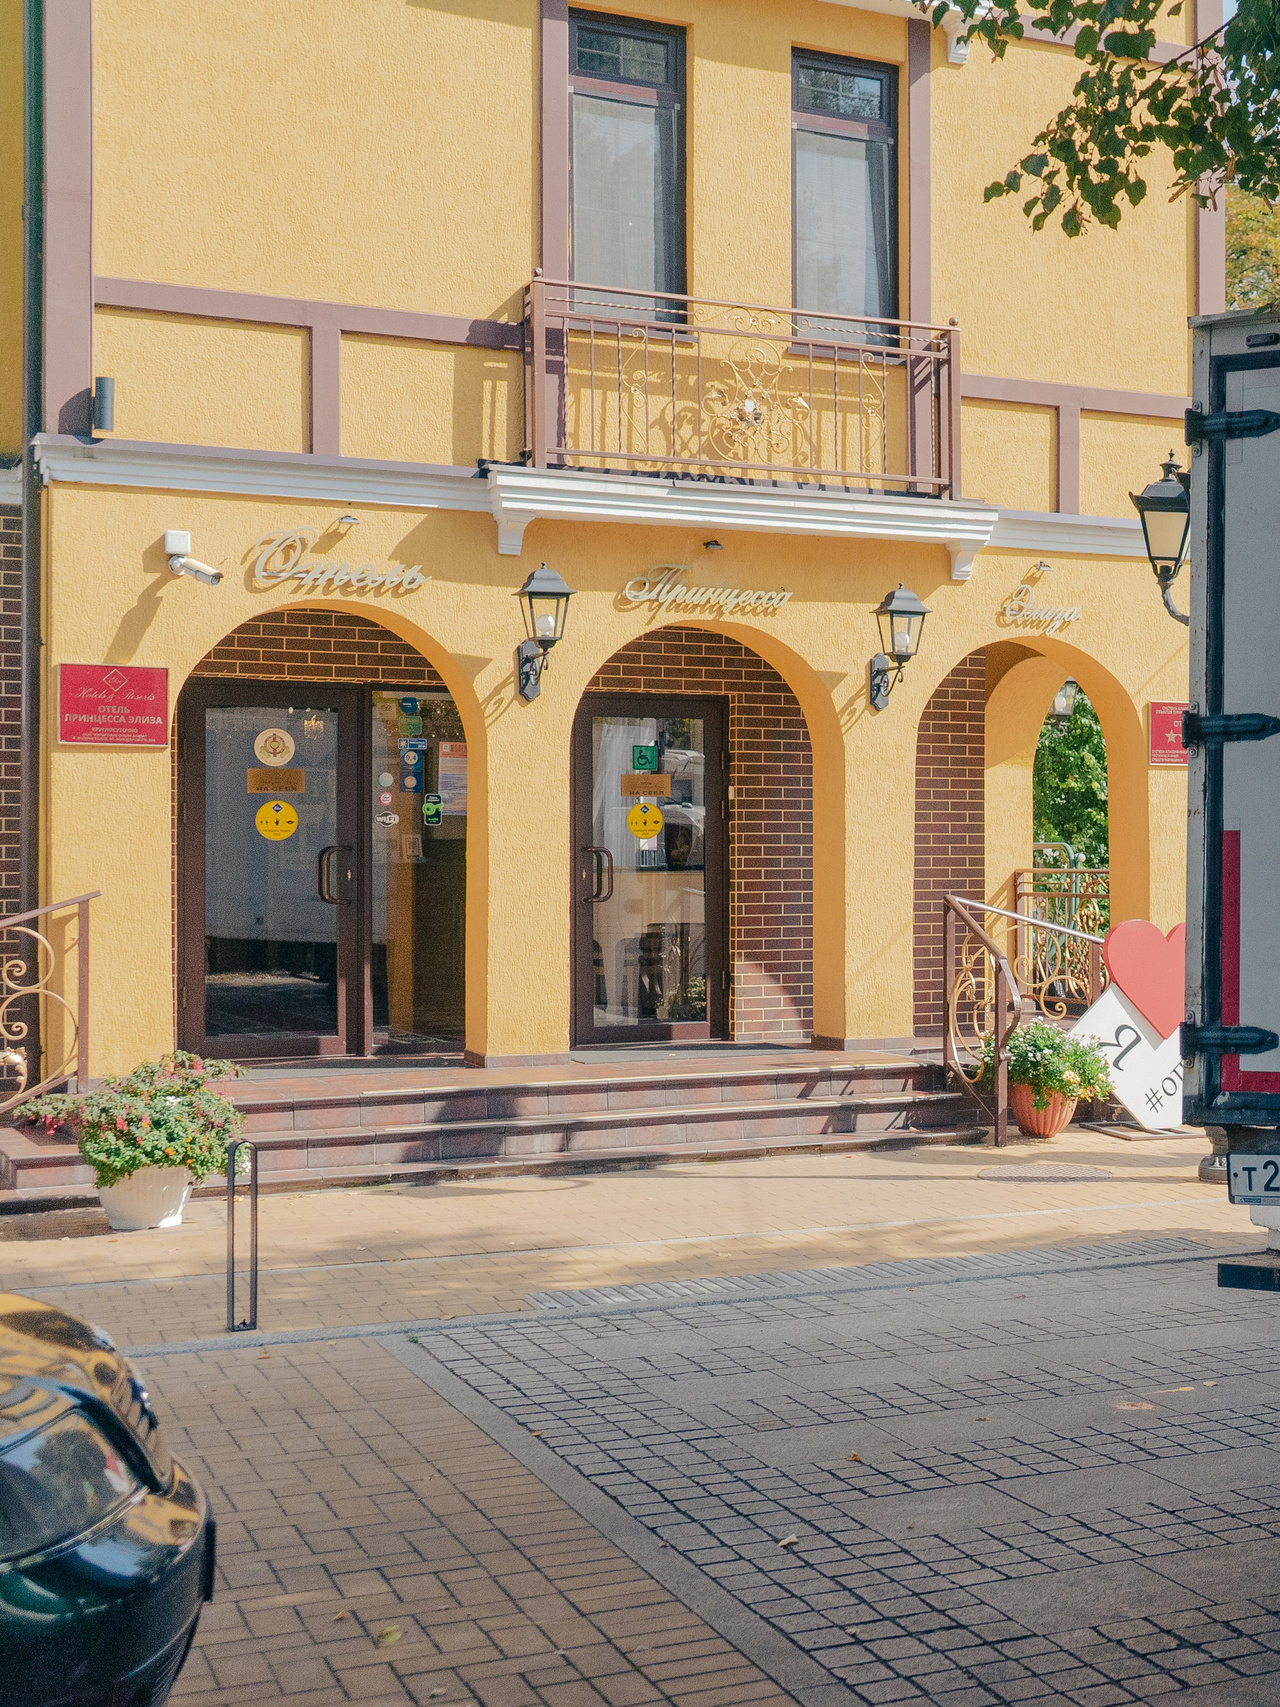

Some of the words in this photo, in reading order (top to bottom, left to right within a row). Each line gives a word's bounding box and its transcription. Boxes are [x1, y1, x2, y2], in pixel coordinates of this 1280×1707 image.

[252, 527, 432, 589] Отель
[625, 563, 793, 615] Принцесса
[1005, 584, 1080, 635] Элиза
[64, 713, 126, 724] ПРИНЦЕССА
[128, 715, 163, 725] ЭЛИЗА
[97, 704, 131, 714] ОТЕЛЬ
[405, 754, 418, 762] 9.4
